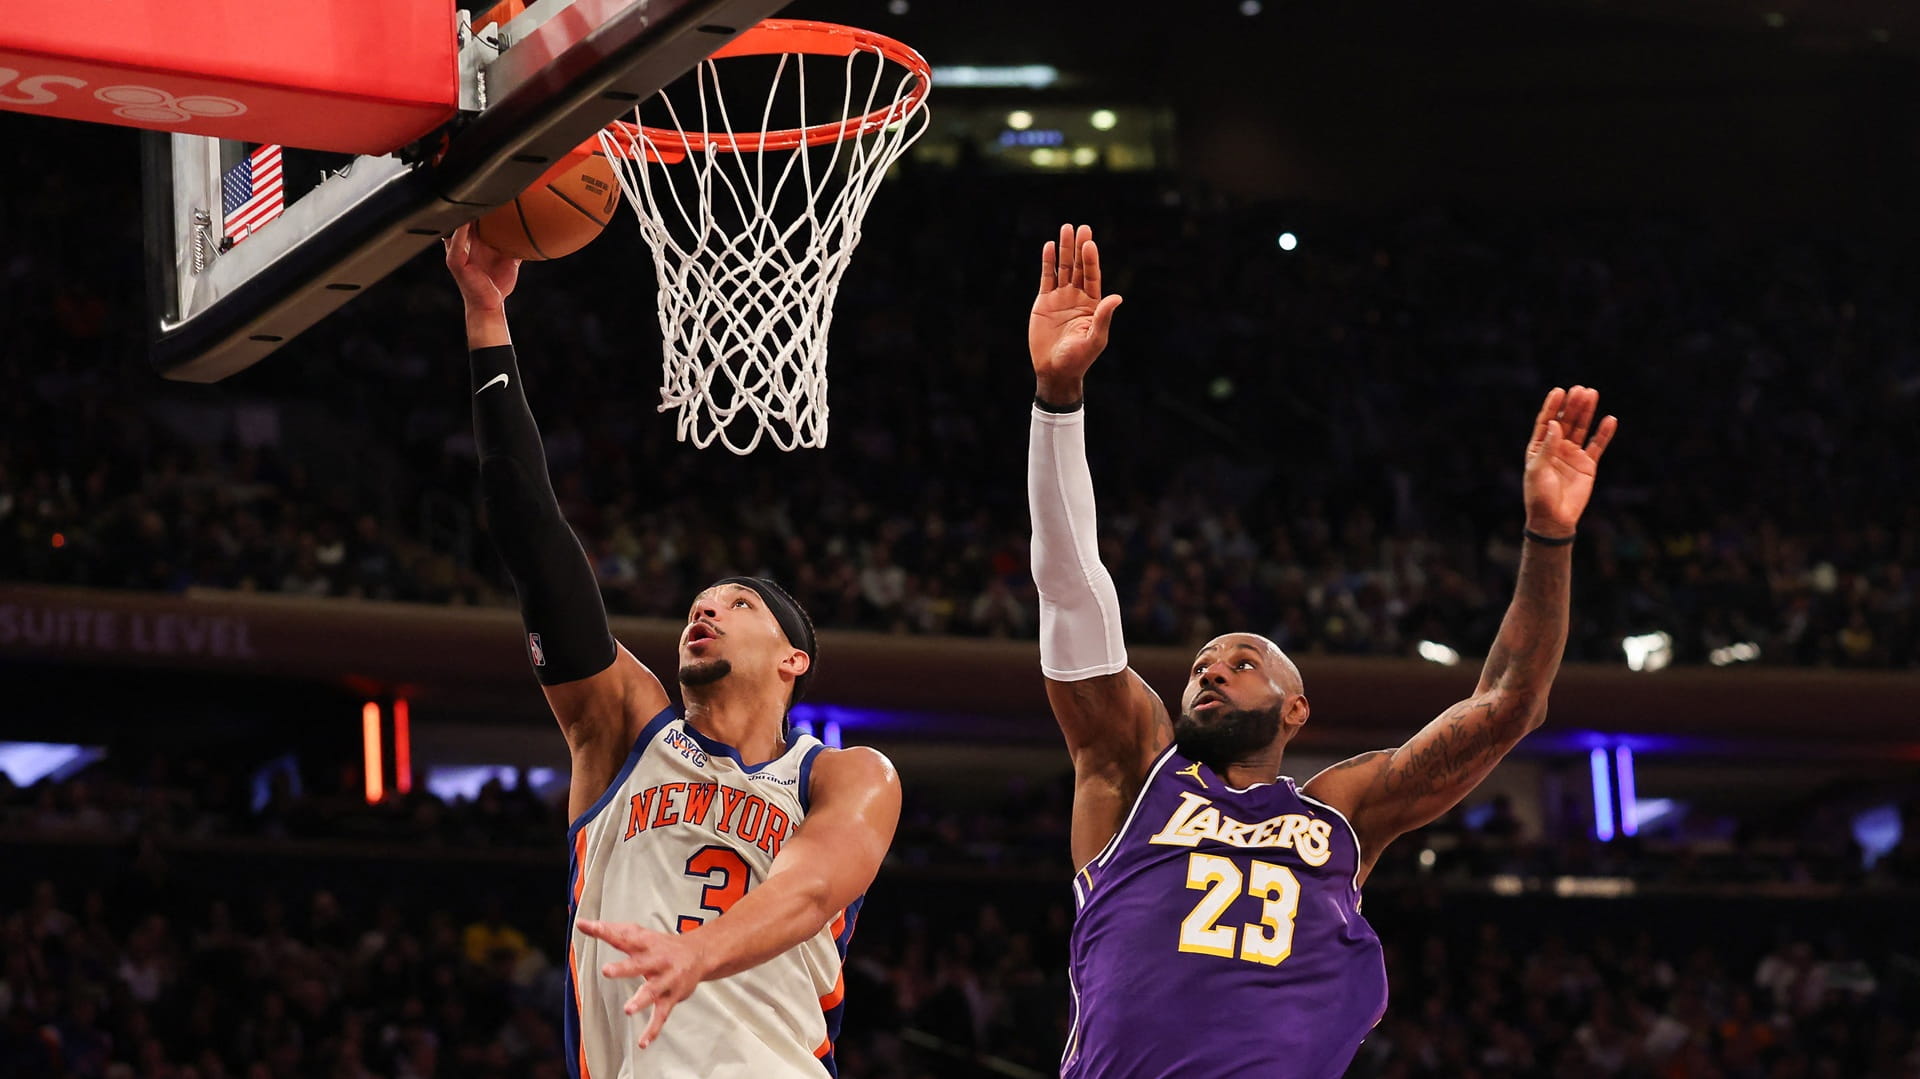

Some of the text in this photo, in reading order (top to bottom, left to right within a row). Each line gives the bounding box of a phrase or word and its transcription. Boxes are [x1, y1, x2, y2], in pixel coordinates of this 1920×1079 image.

[0, 604, 255, 658] SUITE LEVEL
[664, 728, 708, 769] NYC
[625, 782, 800, 858] NEW YOR
[1149, 790, 1333, 867] LAKERS
[676, 844, 753, 935] 3
[1178, 852, 1301, 967] 23
